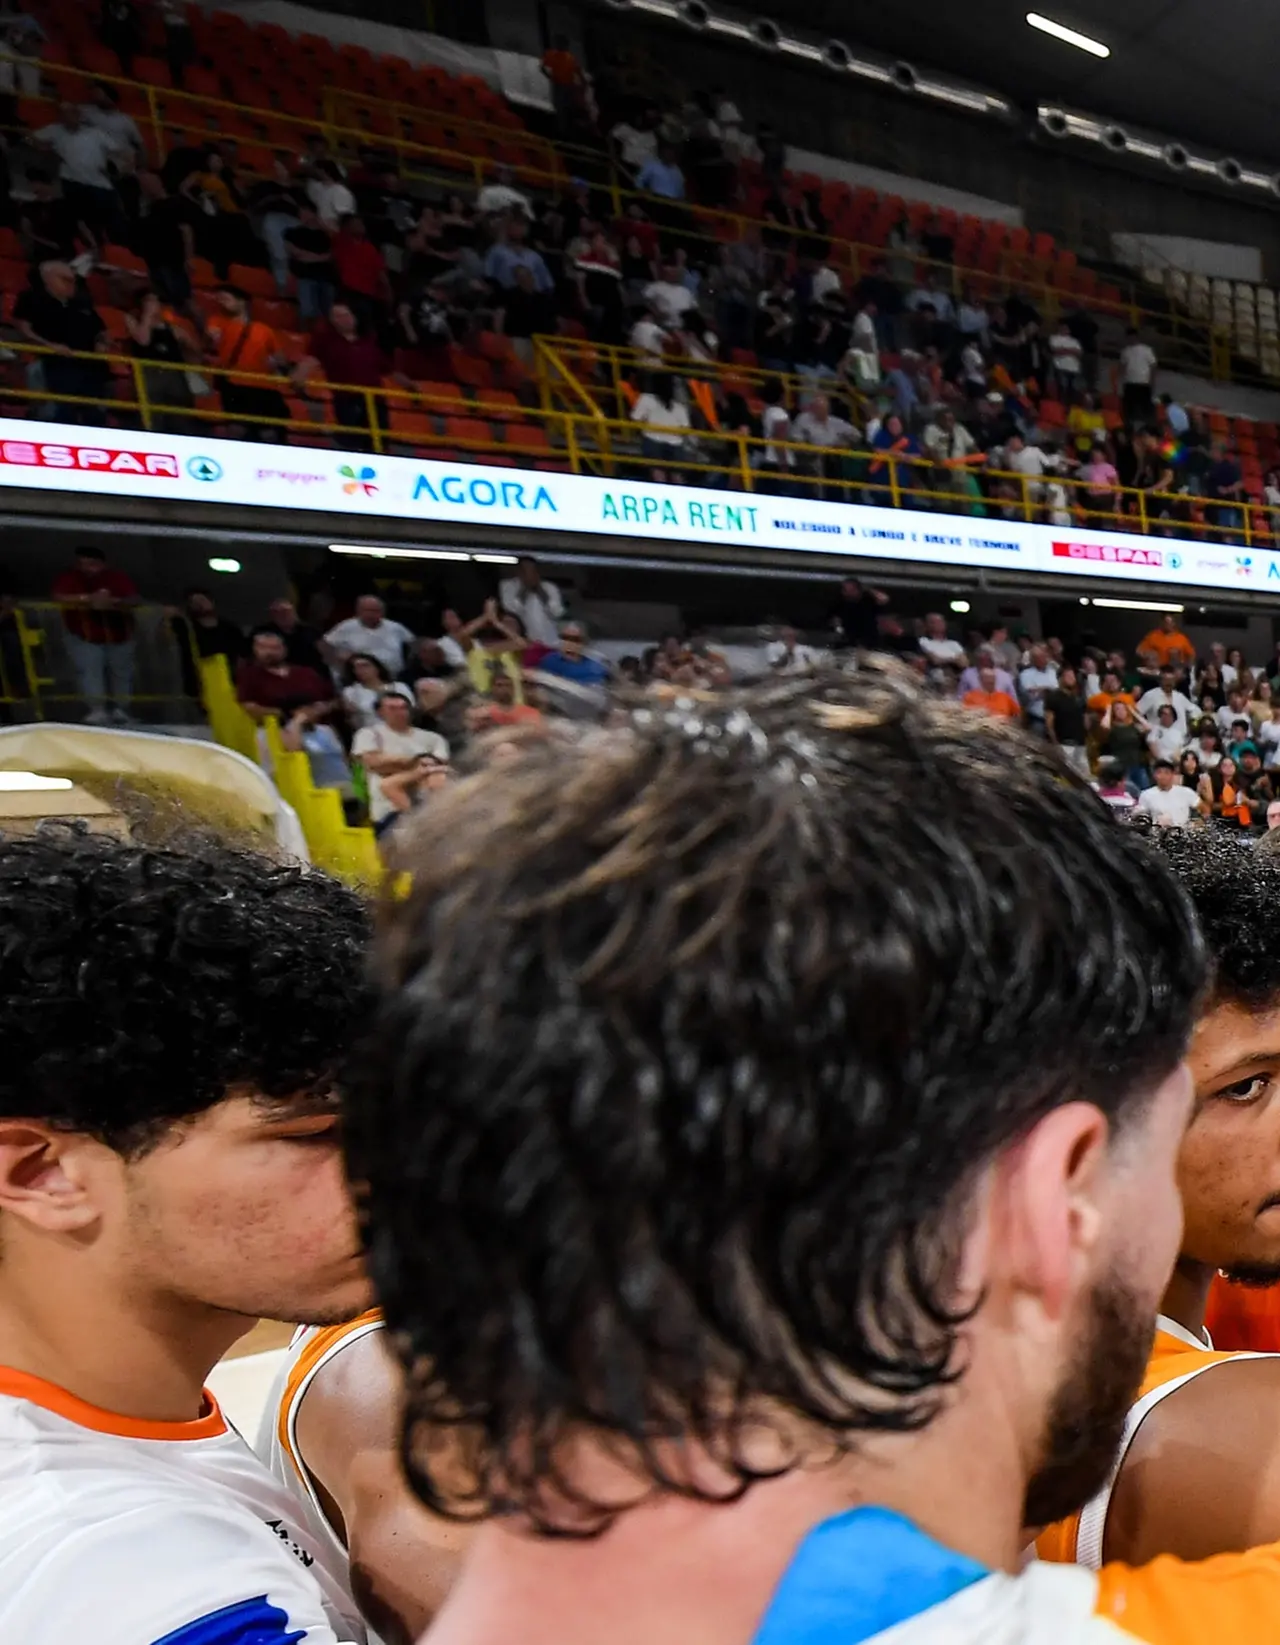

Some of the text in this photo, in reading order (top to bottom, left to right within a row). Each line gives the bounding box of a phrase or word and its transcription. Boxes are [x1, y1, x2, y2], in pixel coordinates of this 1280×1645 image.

[0, 441, 178, 476] ESPAR
[412, 474, 557, 511] AGORA
[602, 493, 757, 533] ARPA RENT
